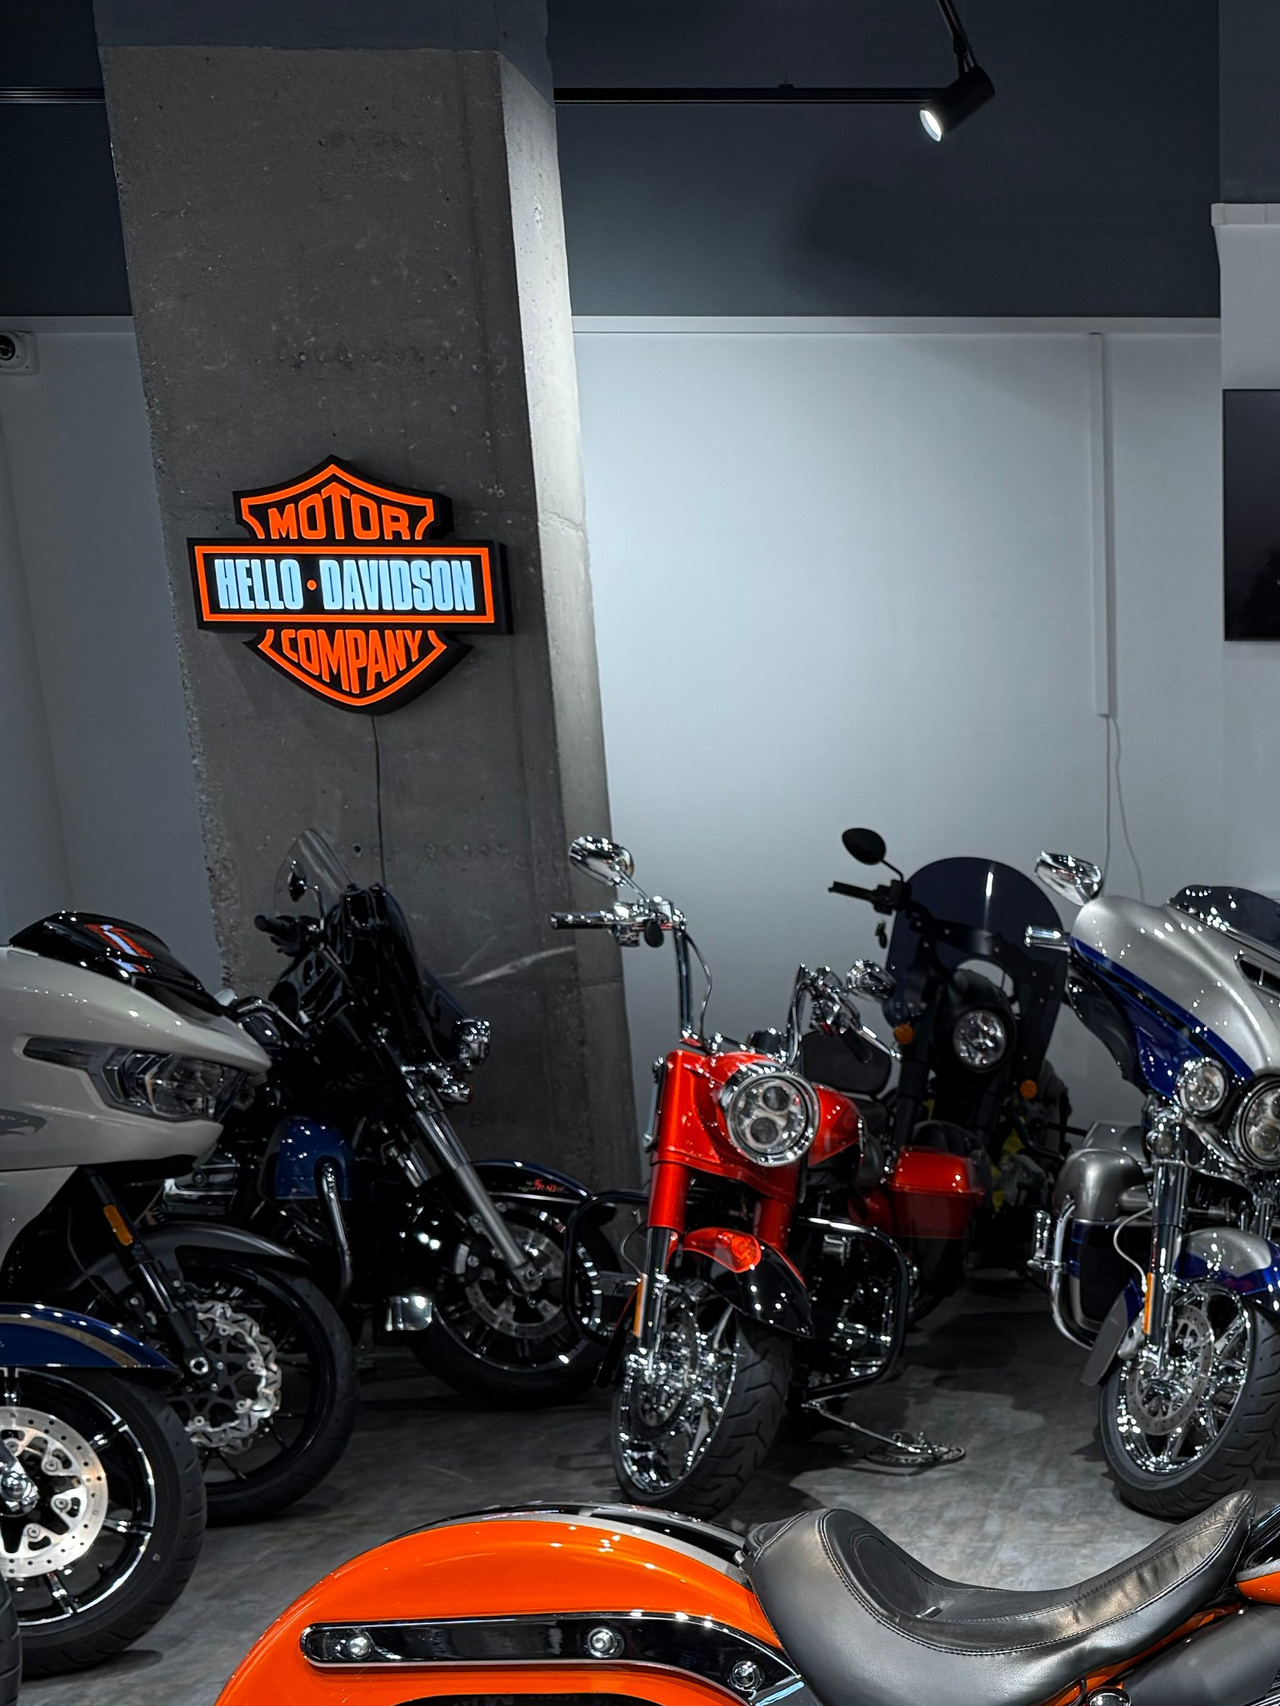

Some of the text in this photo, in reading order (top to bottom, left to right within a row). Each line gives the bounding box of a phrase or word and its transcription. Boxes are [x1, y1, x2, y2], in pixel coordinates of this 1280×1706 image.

[268, 482, 410, 539] MOTOR
[214, 559, 475, 610] HELLO DAVIDSON
[281, 629, 422, 693] COMPANY
